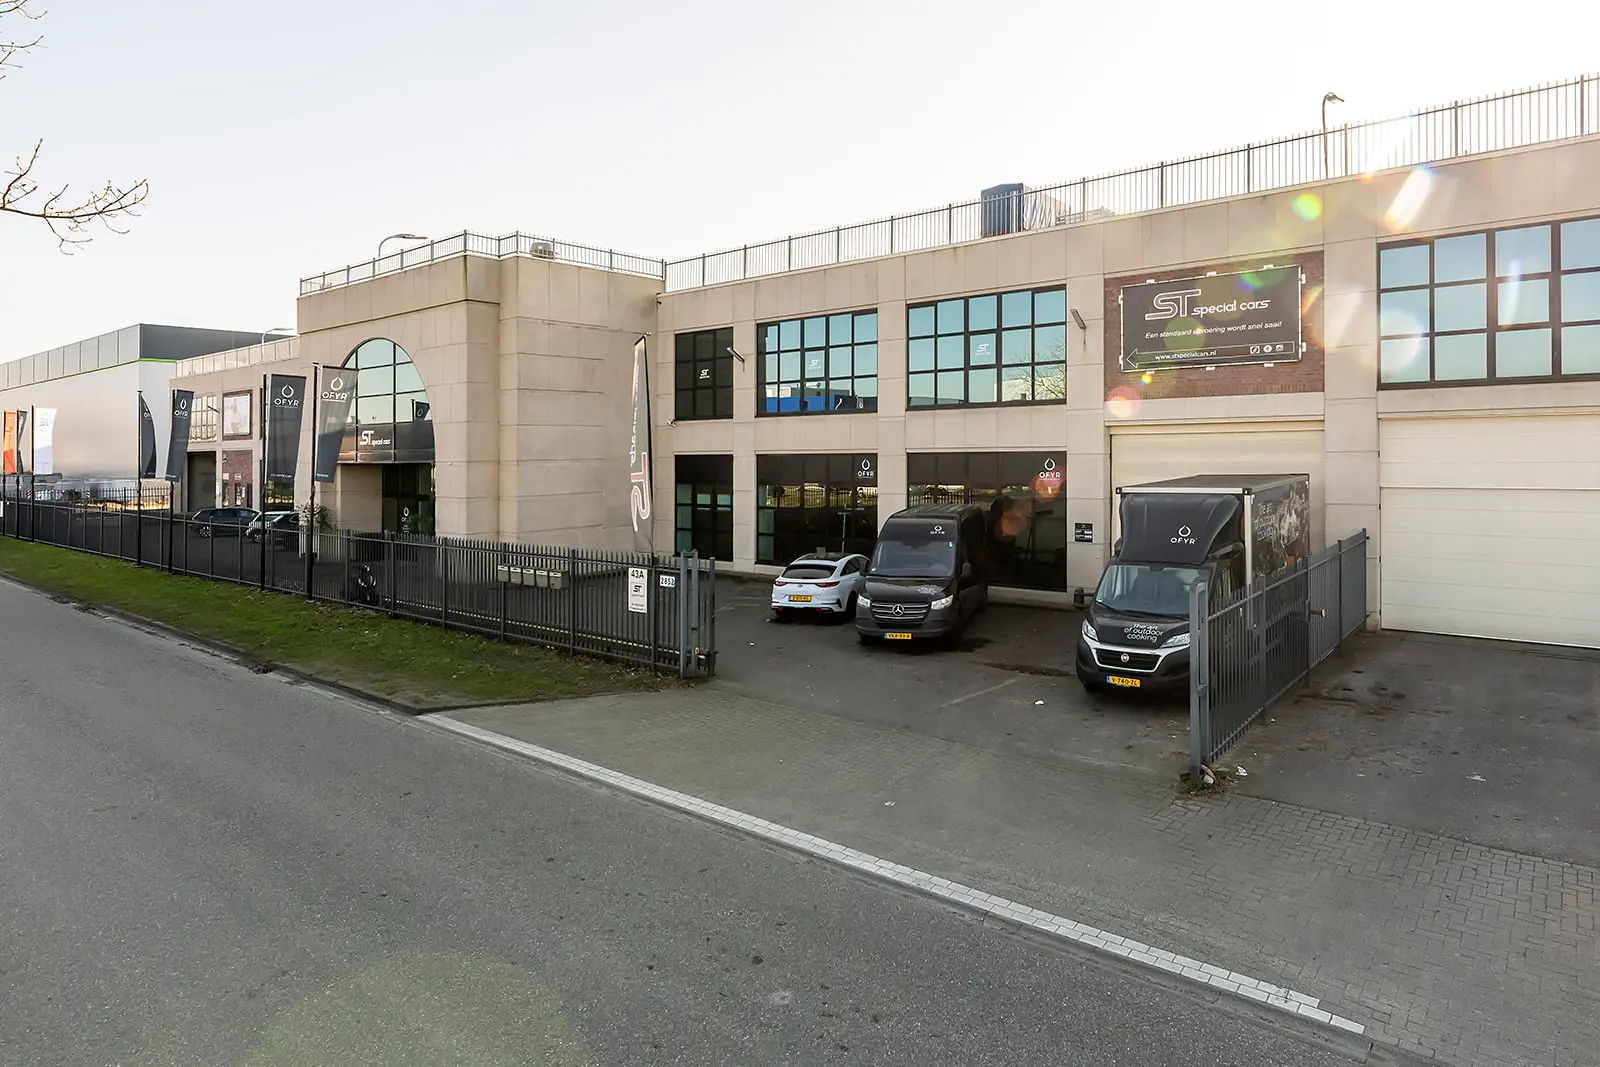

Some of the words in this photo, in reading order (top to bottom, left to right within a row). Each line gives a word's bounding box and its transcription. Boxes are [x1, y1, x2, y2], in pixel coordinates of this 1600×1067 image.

[1145, 289, 1201, 320] ST
[1191, 300, 1237, 318] special
[1240, 300, 1271, 310] cars
[1160, 329, 1192, 338] standaard
[1248, 322, 1263, 330] snel
[977, 344, 990, 353] ST
[1155, 350, 1217, 360] www.stspecialcars.nl
[322, 391, 347, 400] OFYR
[274, 398, 299, 407] OFYR
[360, 430, 374, 445] ST
[1039, 471, 1061, 479] OFYR
[1170, 537, 1196, 545] OFYR
[631, 569, 645, 580] 43A
[633, 584, 642, 593] ST
[1123, 626, 1133, 634] of
[1132, 628, 1164, 636] outdoor
[1126, 633, 1158, 643] cooking
